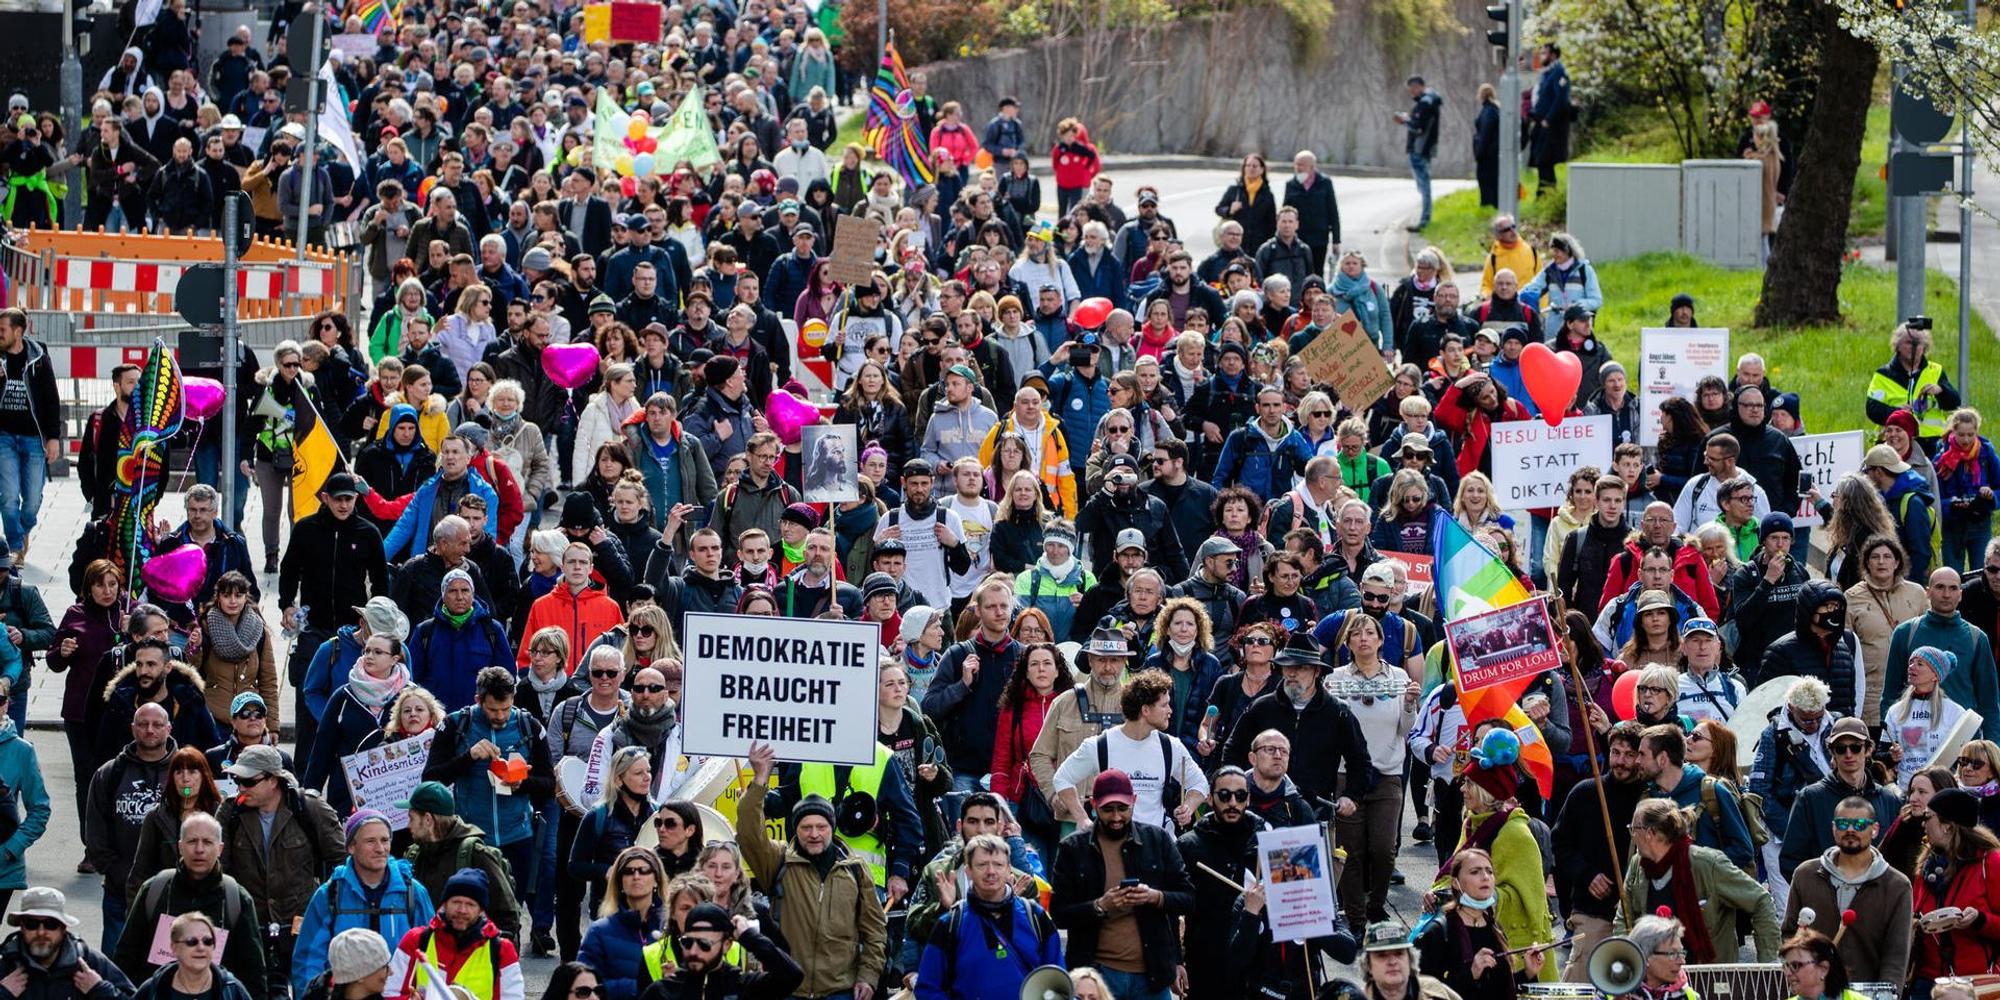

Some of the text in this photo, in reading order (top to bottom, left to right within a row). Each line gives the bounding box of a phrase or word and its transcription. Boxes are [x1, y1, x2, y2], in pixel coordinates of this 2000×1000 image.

[1495, 424, 1595, 444] JESU LIEBE
[1520, 453, 1580, 470] STATT
[1798, 440, 1835, 466] cht
[1511, 482, 1566, 500] DIKTA
[698, 634, 865, 667] DEMOKRATIE
[1463, 666, 1498, 684] DRUM
[1500, 659, 1525, 674] FOR
[1525, 651, 1556, 667] LOVE
[720, 674, 841, 705] BRAUCHT
[1912, 710, 1930, 719] Lieb
[722, 713, 836, 744] FREIHEIT
[116, 799, 144, 814] ROCK
